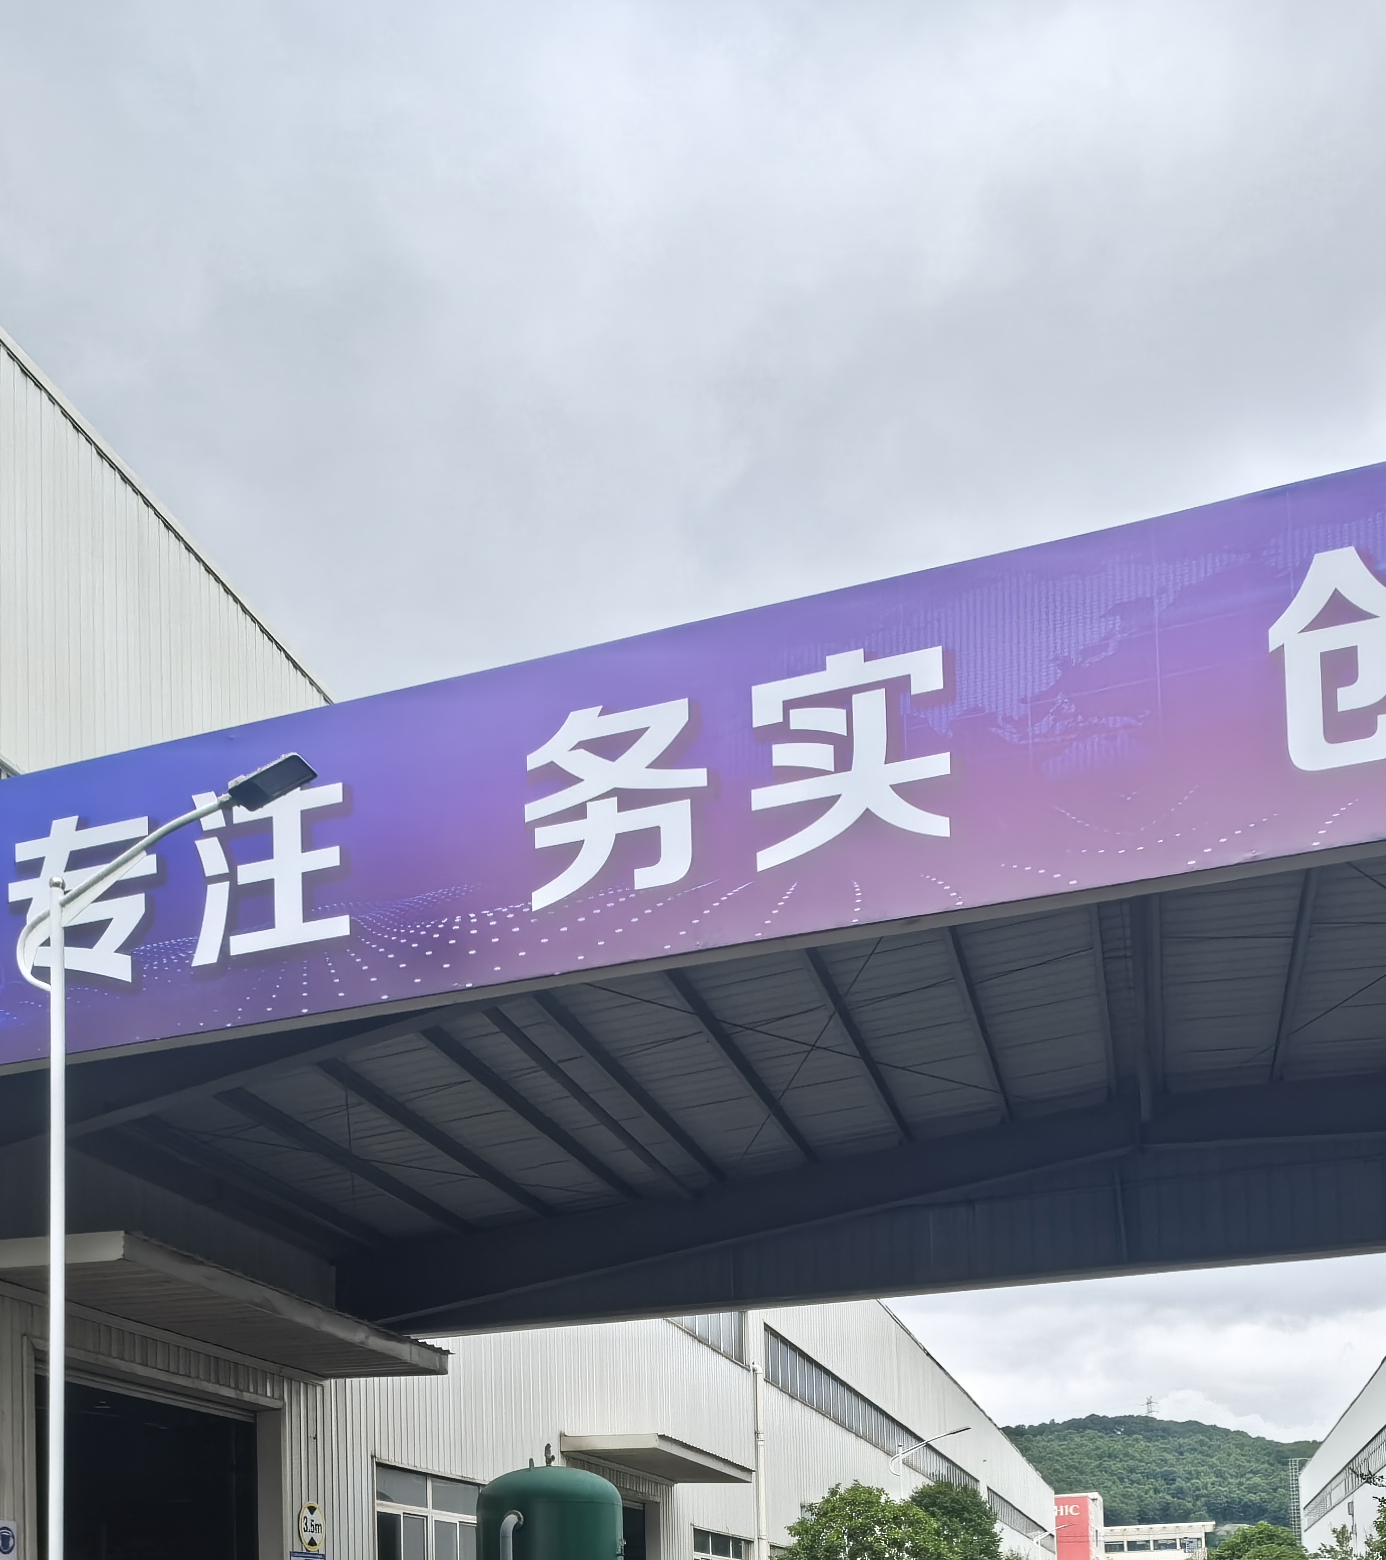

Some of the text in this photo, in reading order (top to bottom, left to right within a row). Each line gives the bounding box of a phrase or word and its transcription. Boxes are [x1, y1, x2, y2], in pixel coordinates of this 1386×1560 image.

[8, 780, 351, 983] 专注
[524, 645, 951, 913] 务实
[303, 1516, 322, 1534] 3.5m
